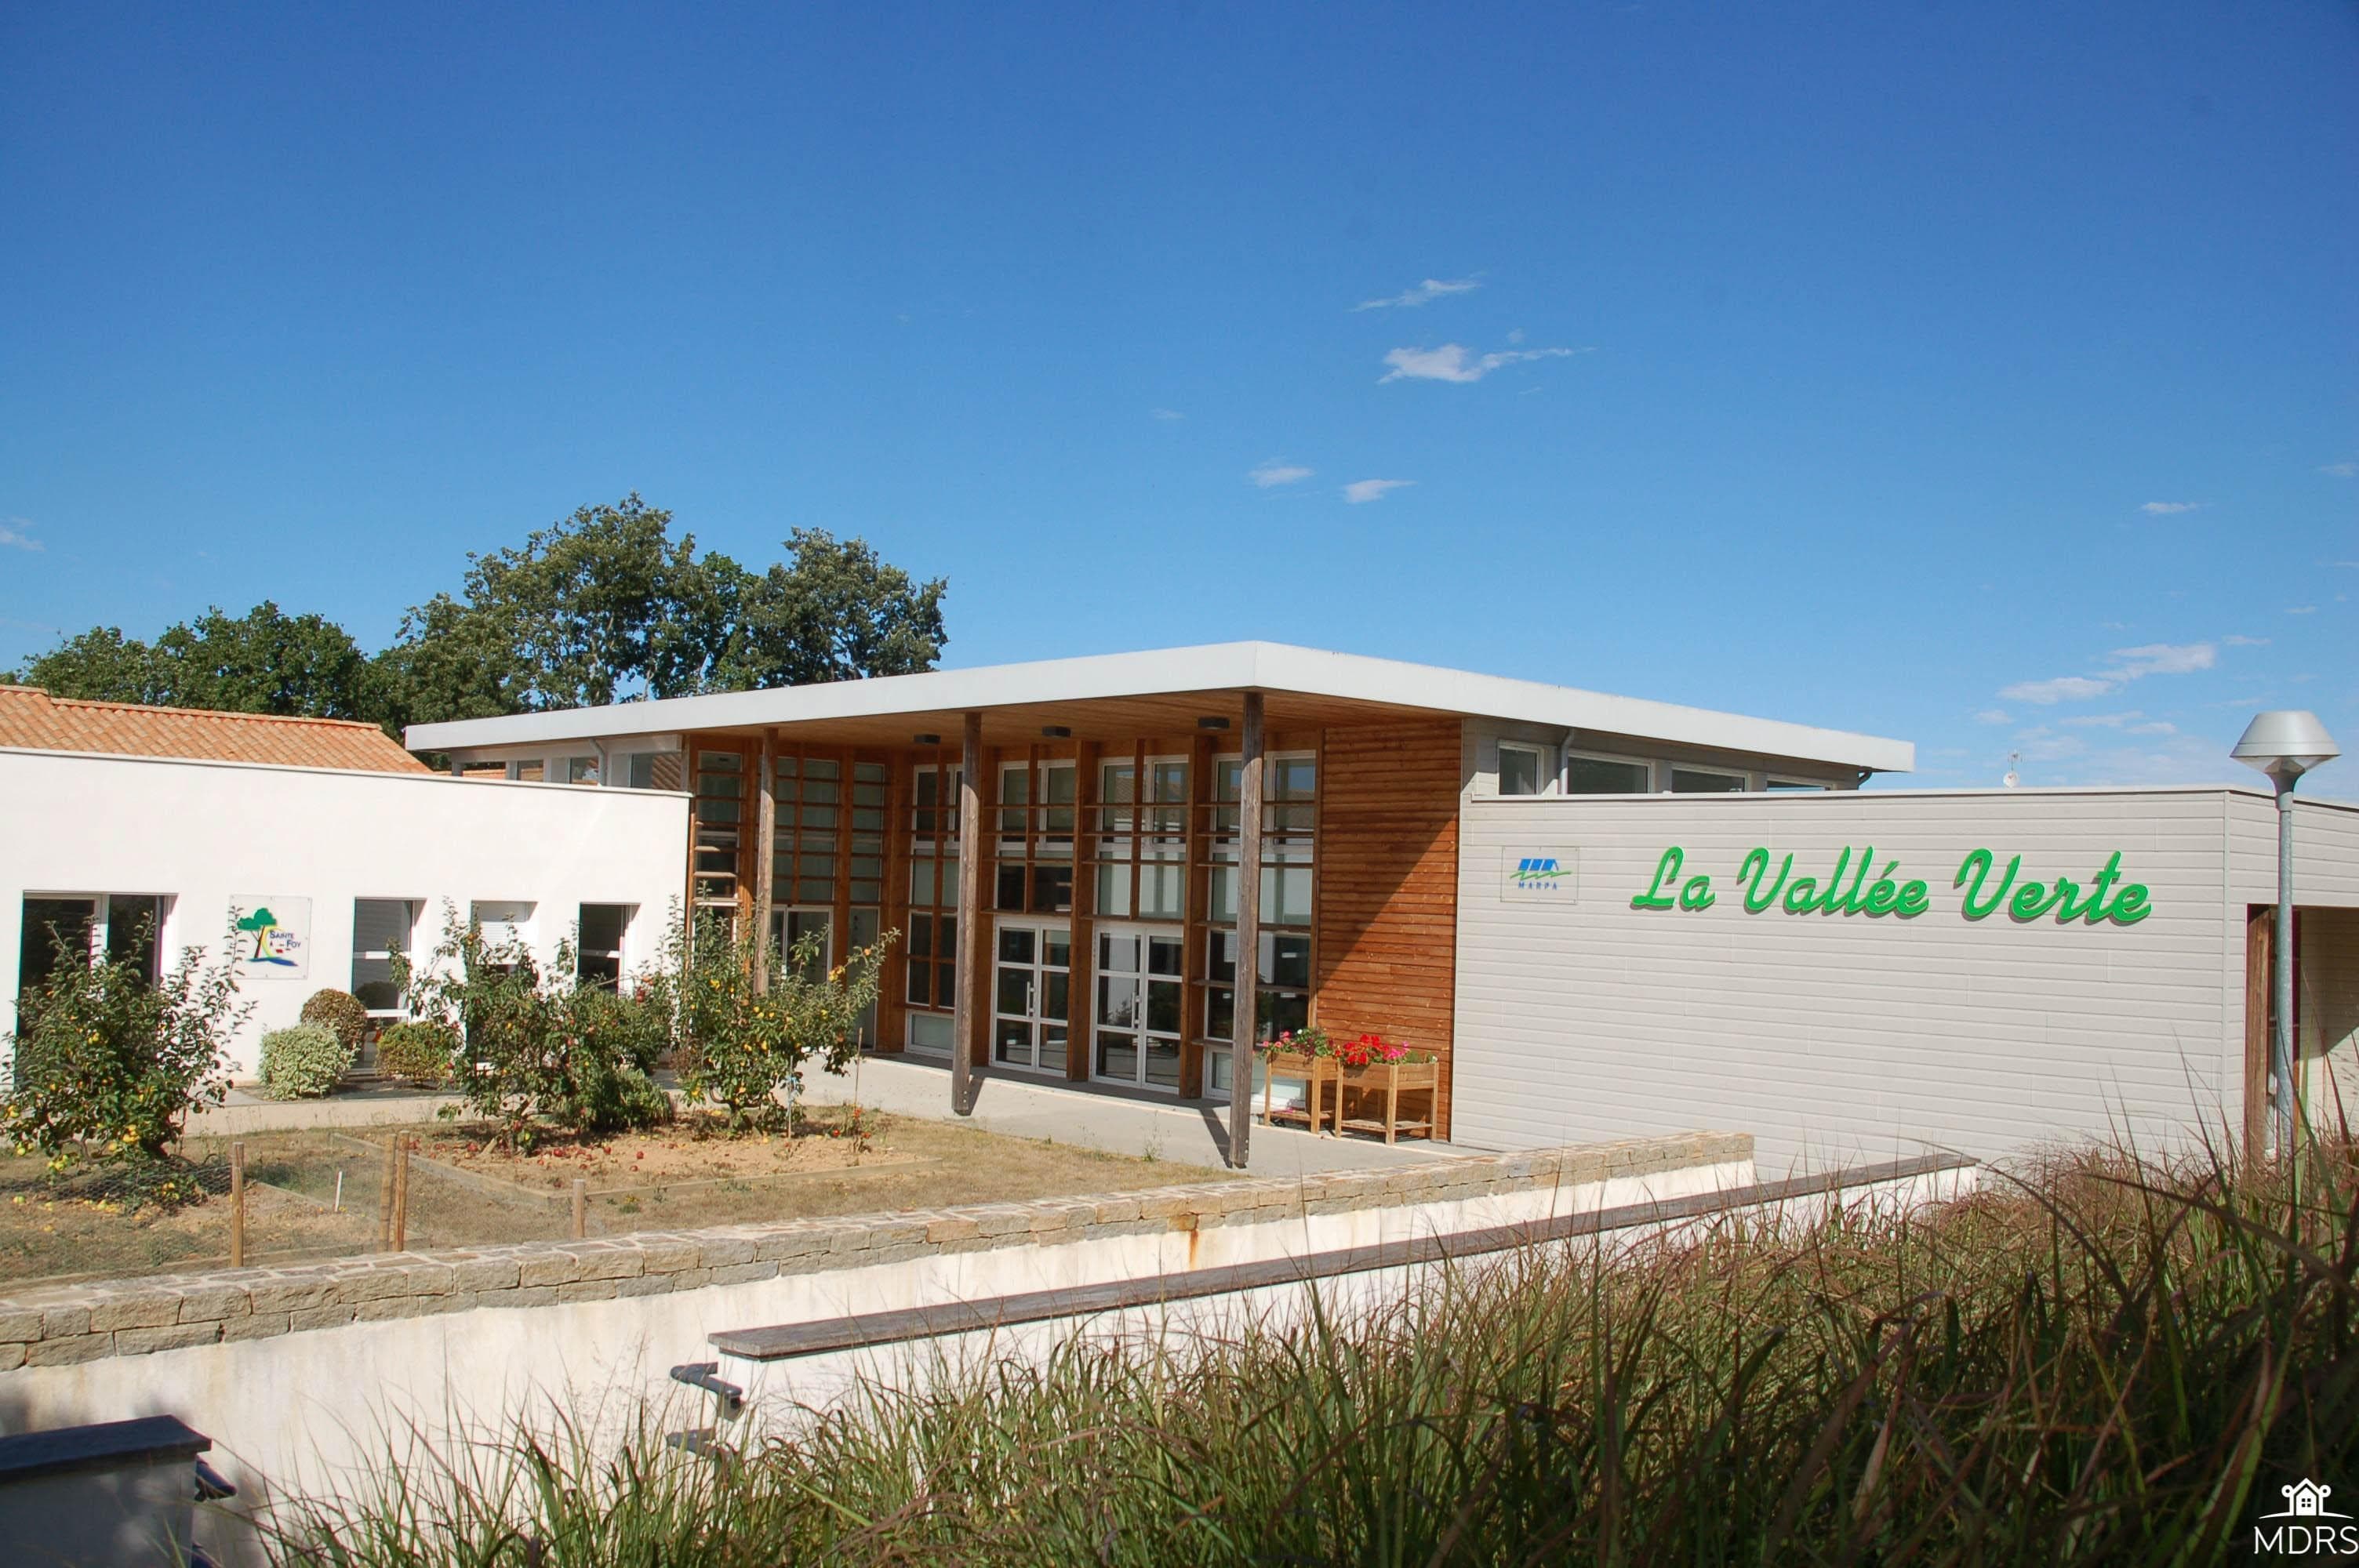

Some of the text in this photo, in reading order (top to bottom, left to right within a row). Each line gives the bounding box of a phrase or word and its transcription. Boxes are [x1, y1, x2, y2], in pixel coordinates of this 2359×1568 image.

[1518, 881, 1557, 890] MARPA
[1630, 845, 2152, 923] La Vallée Verte
